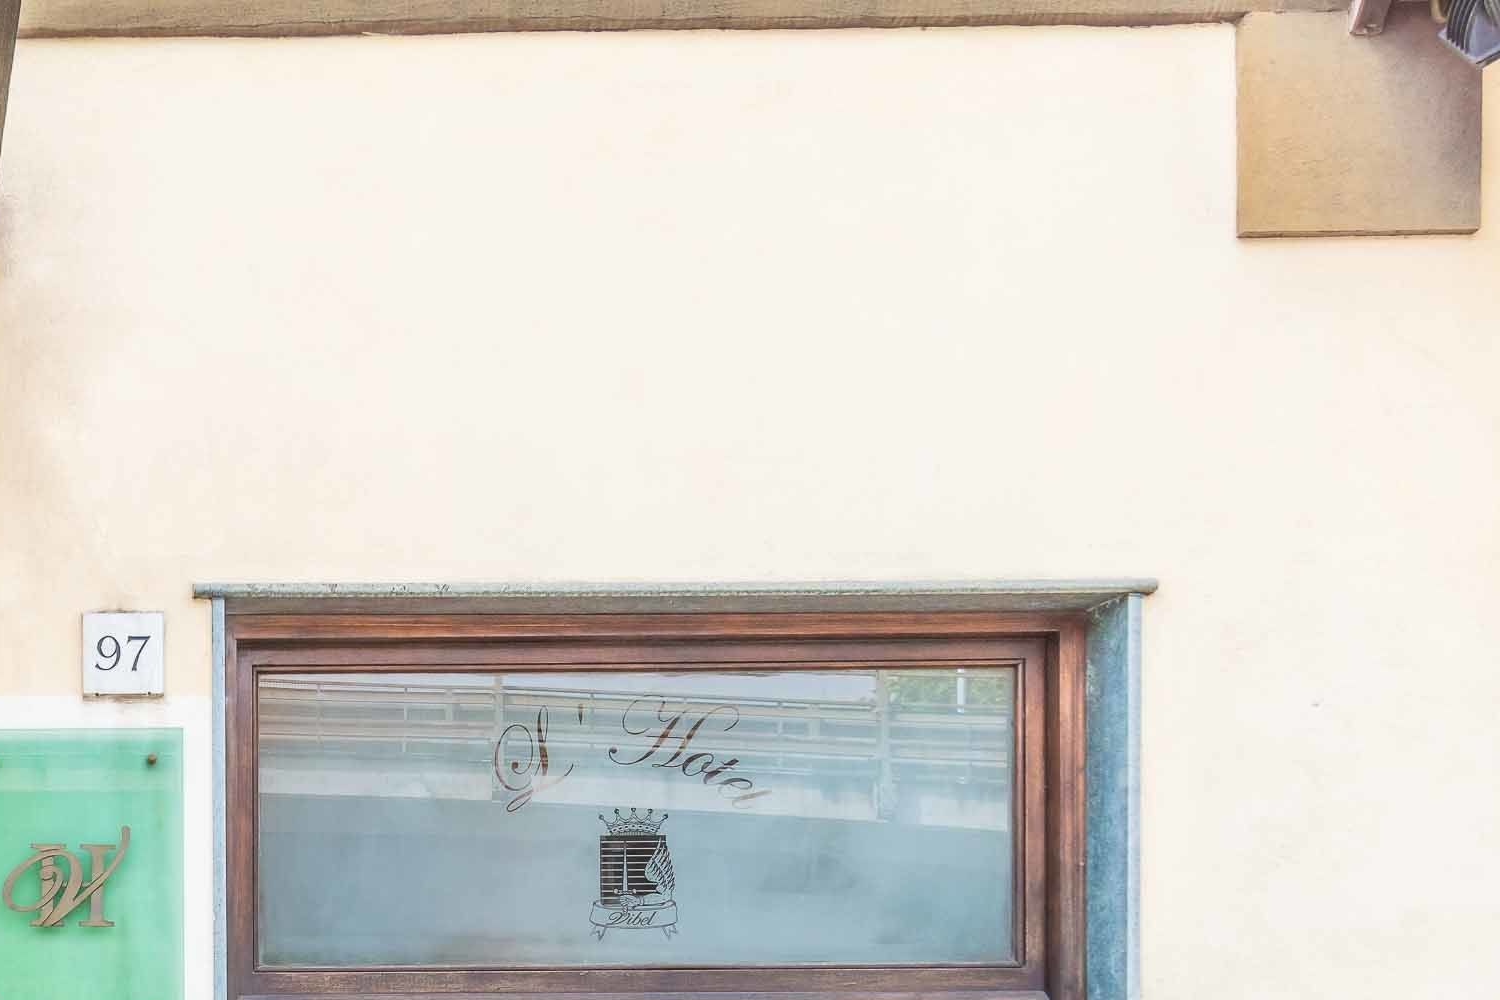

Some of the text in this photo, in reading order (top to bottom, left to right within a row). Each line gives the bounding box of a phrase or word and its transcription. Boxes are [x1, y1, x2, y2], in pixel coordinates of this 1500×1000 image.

[93, 634, 152, 673] 97
[607, 694, 773, 810] Hotel
[608, 911, 658, 927] Vibel
